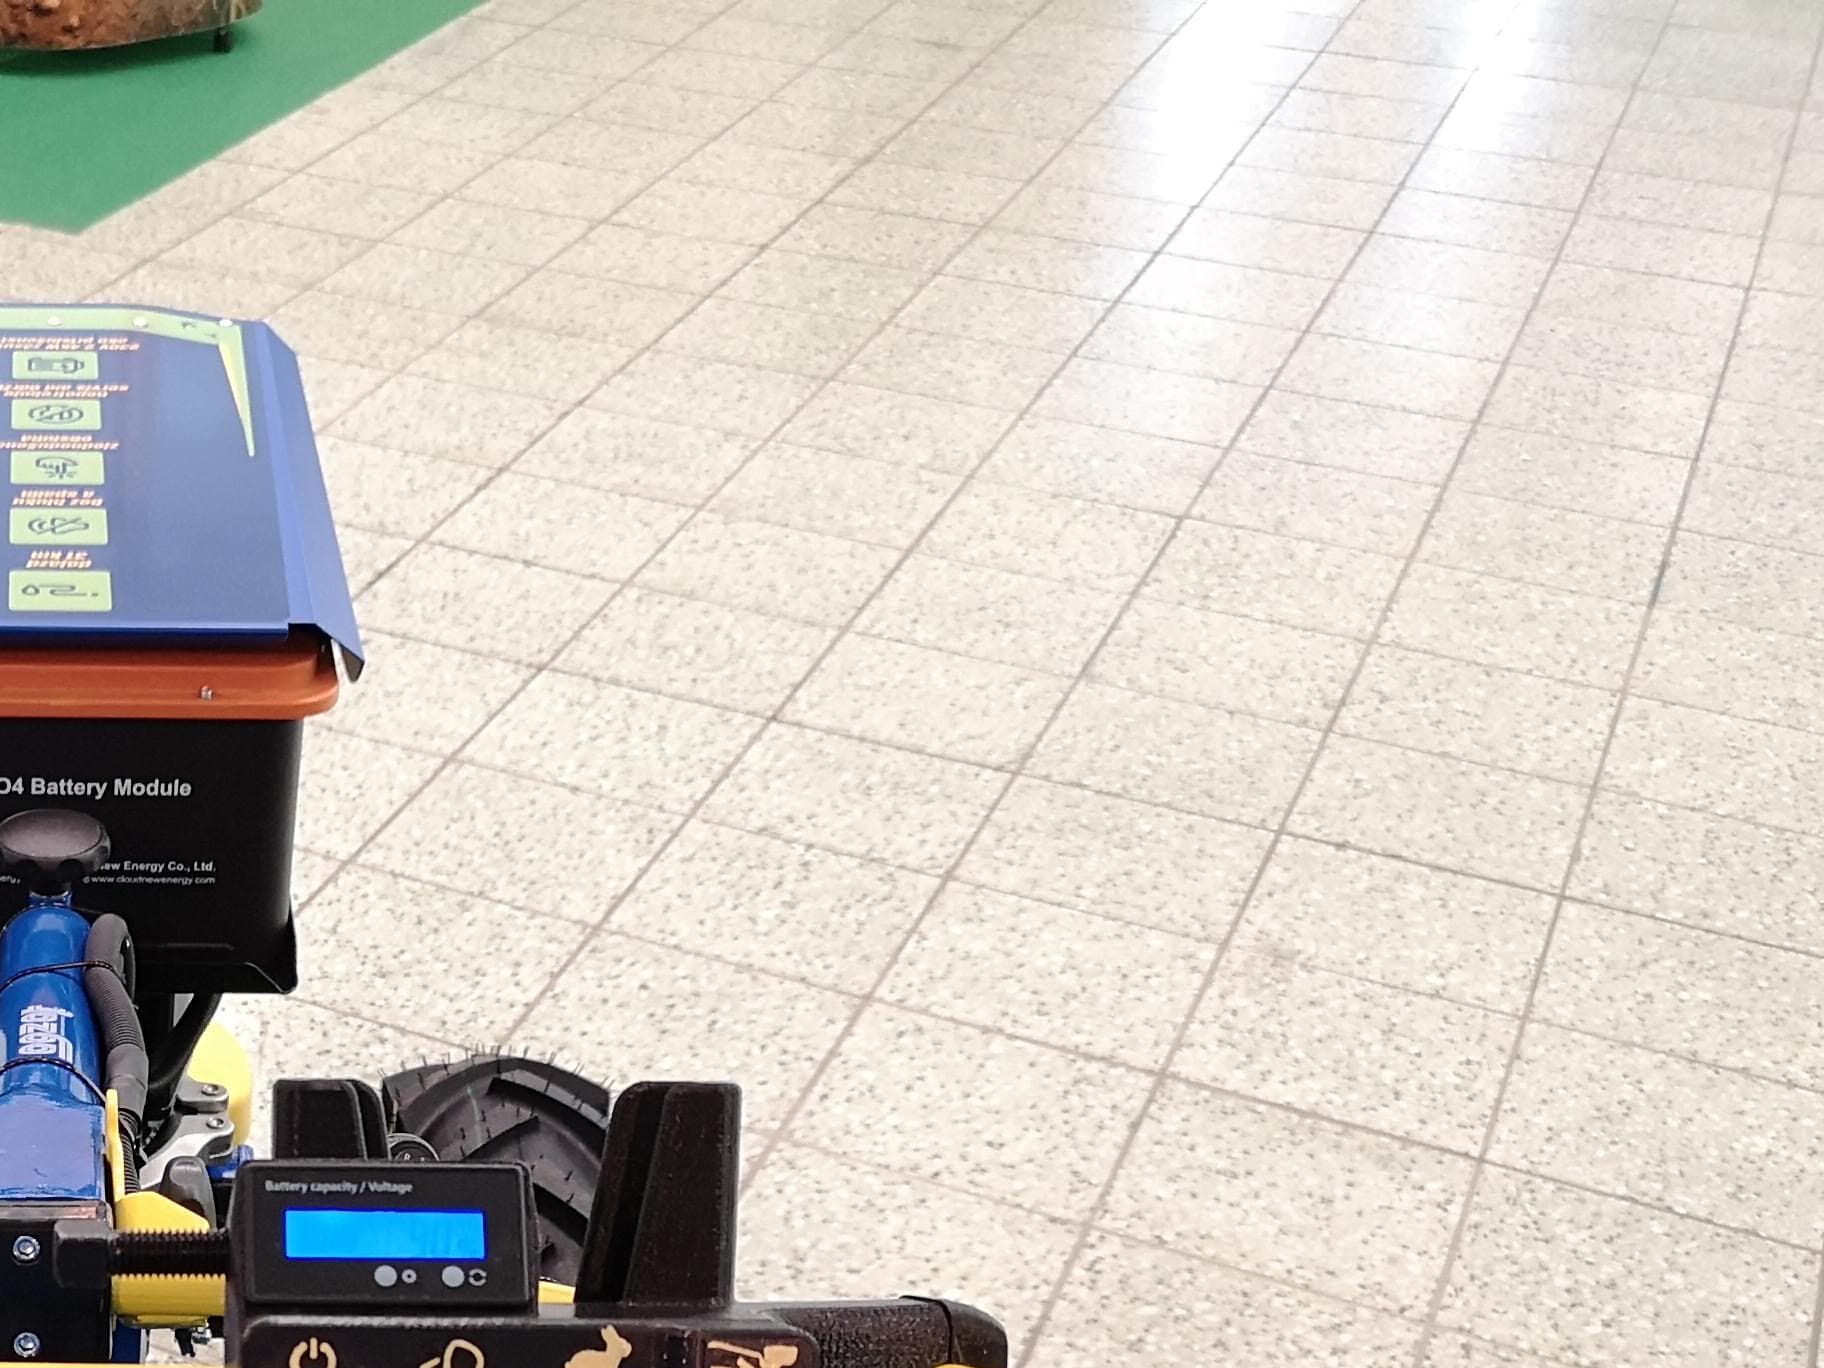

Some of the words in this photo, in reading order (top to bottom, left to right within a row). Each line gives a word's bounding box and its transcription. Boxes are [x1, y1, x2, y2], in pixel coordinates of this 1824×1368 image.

[31, 777, 107, 800] Battery
[113, 777, 192, 797] Module
[100, 861, 120, 871] ew
[123, 860, 165, 873] Energy
[264, 1179, 308, 1195] Battery
[310, 1180, 358, 1195] capacity
[367, 1180, 413, 1195] Voltage
